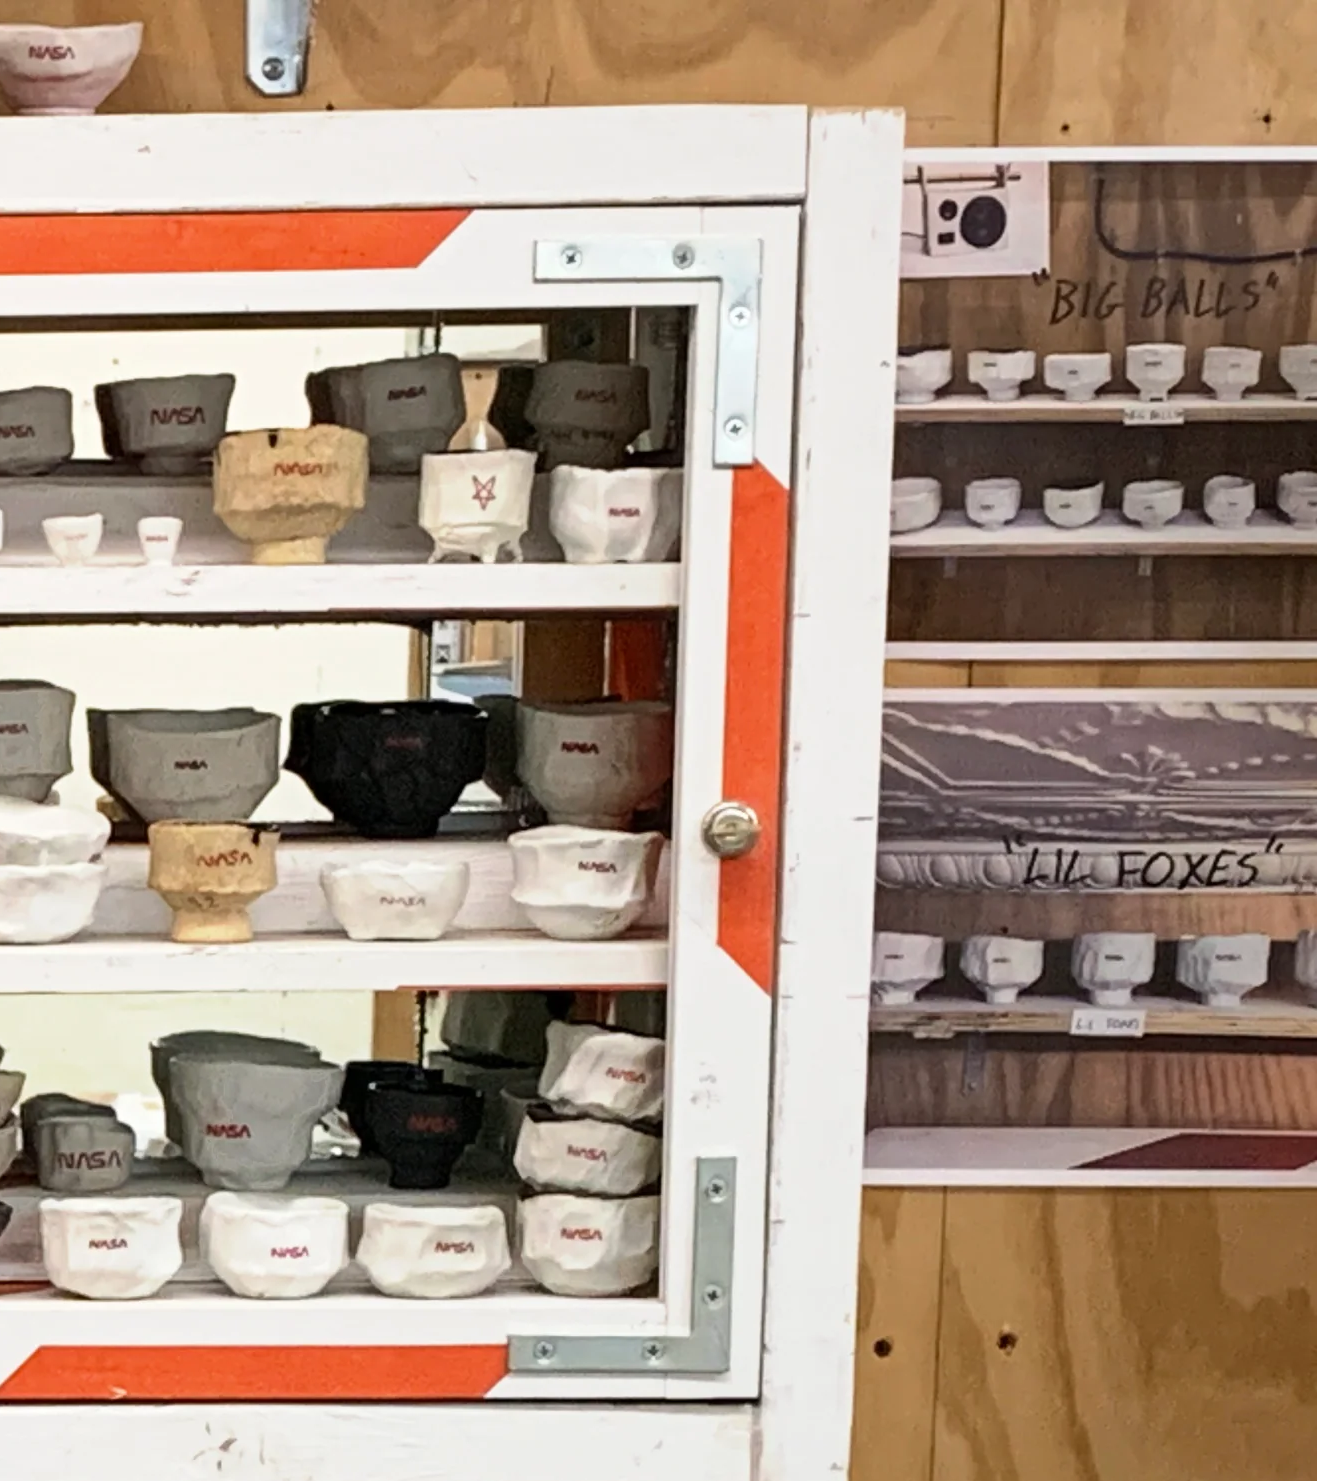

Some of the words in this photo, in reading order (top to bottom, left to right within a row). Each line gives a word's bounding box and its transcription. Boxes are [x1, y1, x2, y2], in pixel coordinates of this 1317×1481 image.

[28, 45, 76, 61] NASA
[149, 406, 206, 426] NASA
[205, 1123, 252, 1139] NASA
[56, 1150, 123, 1171] NASA
[560, 1227, 603, 1241] NASA
[270, 1246, 310, 1259] NASA
[434, 1240, 475, 1253] NASA
